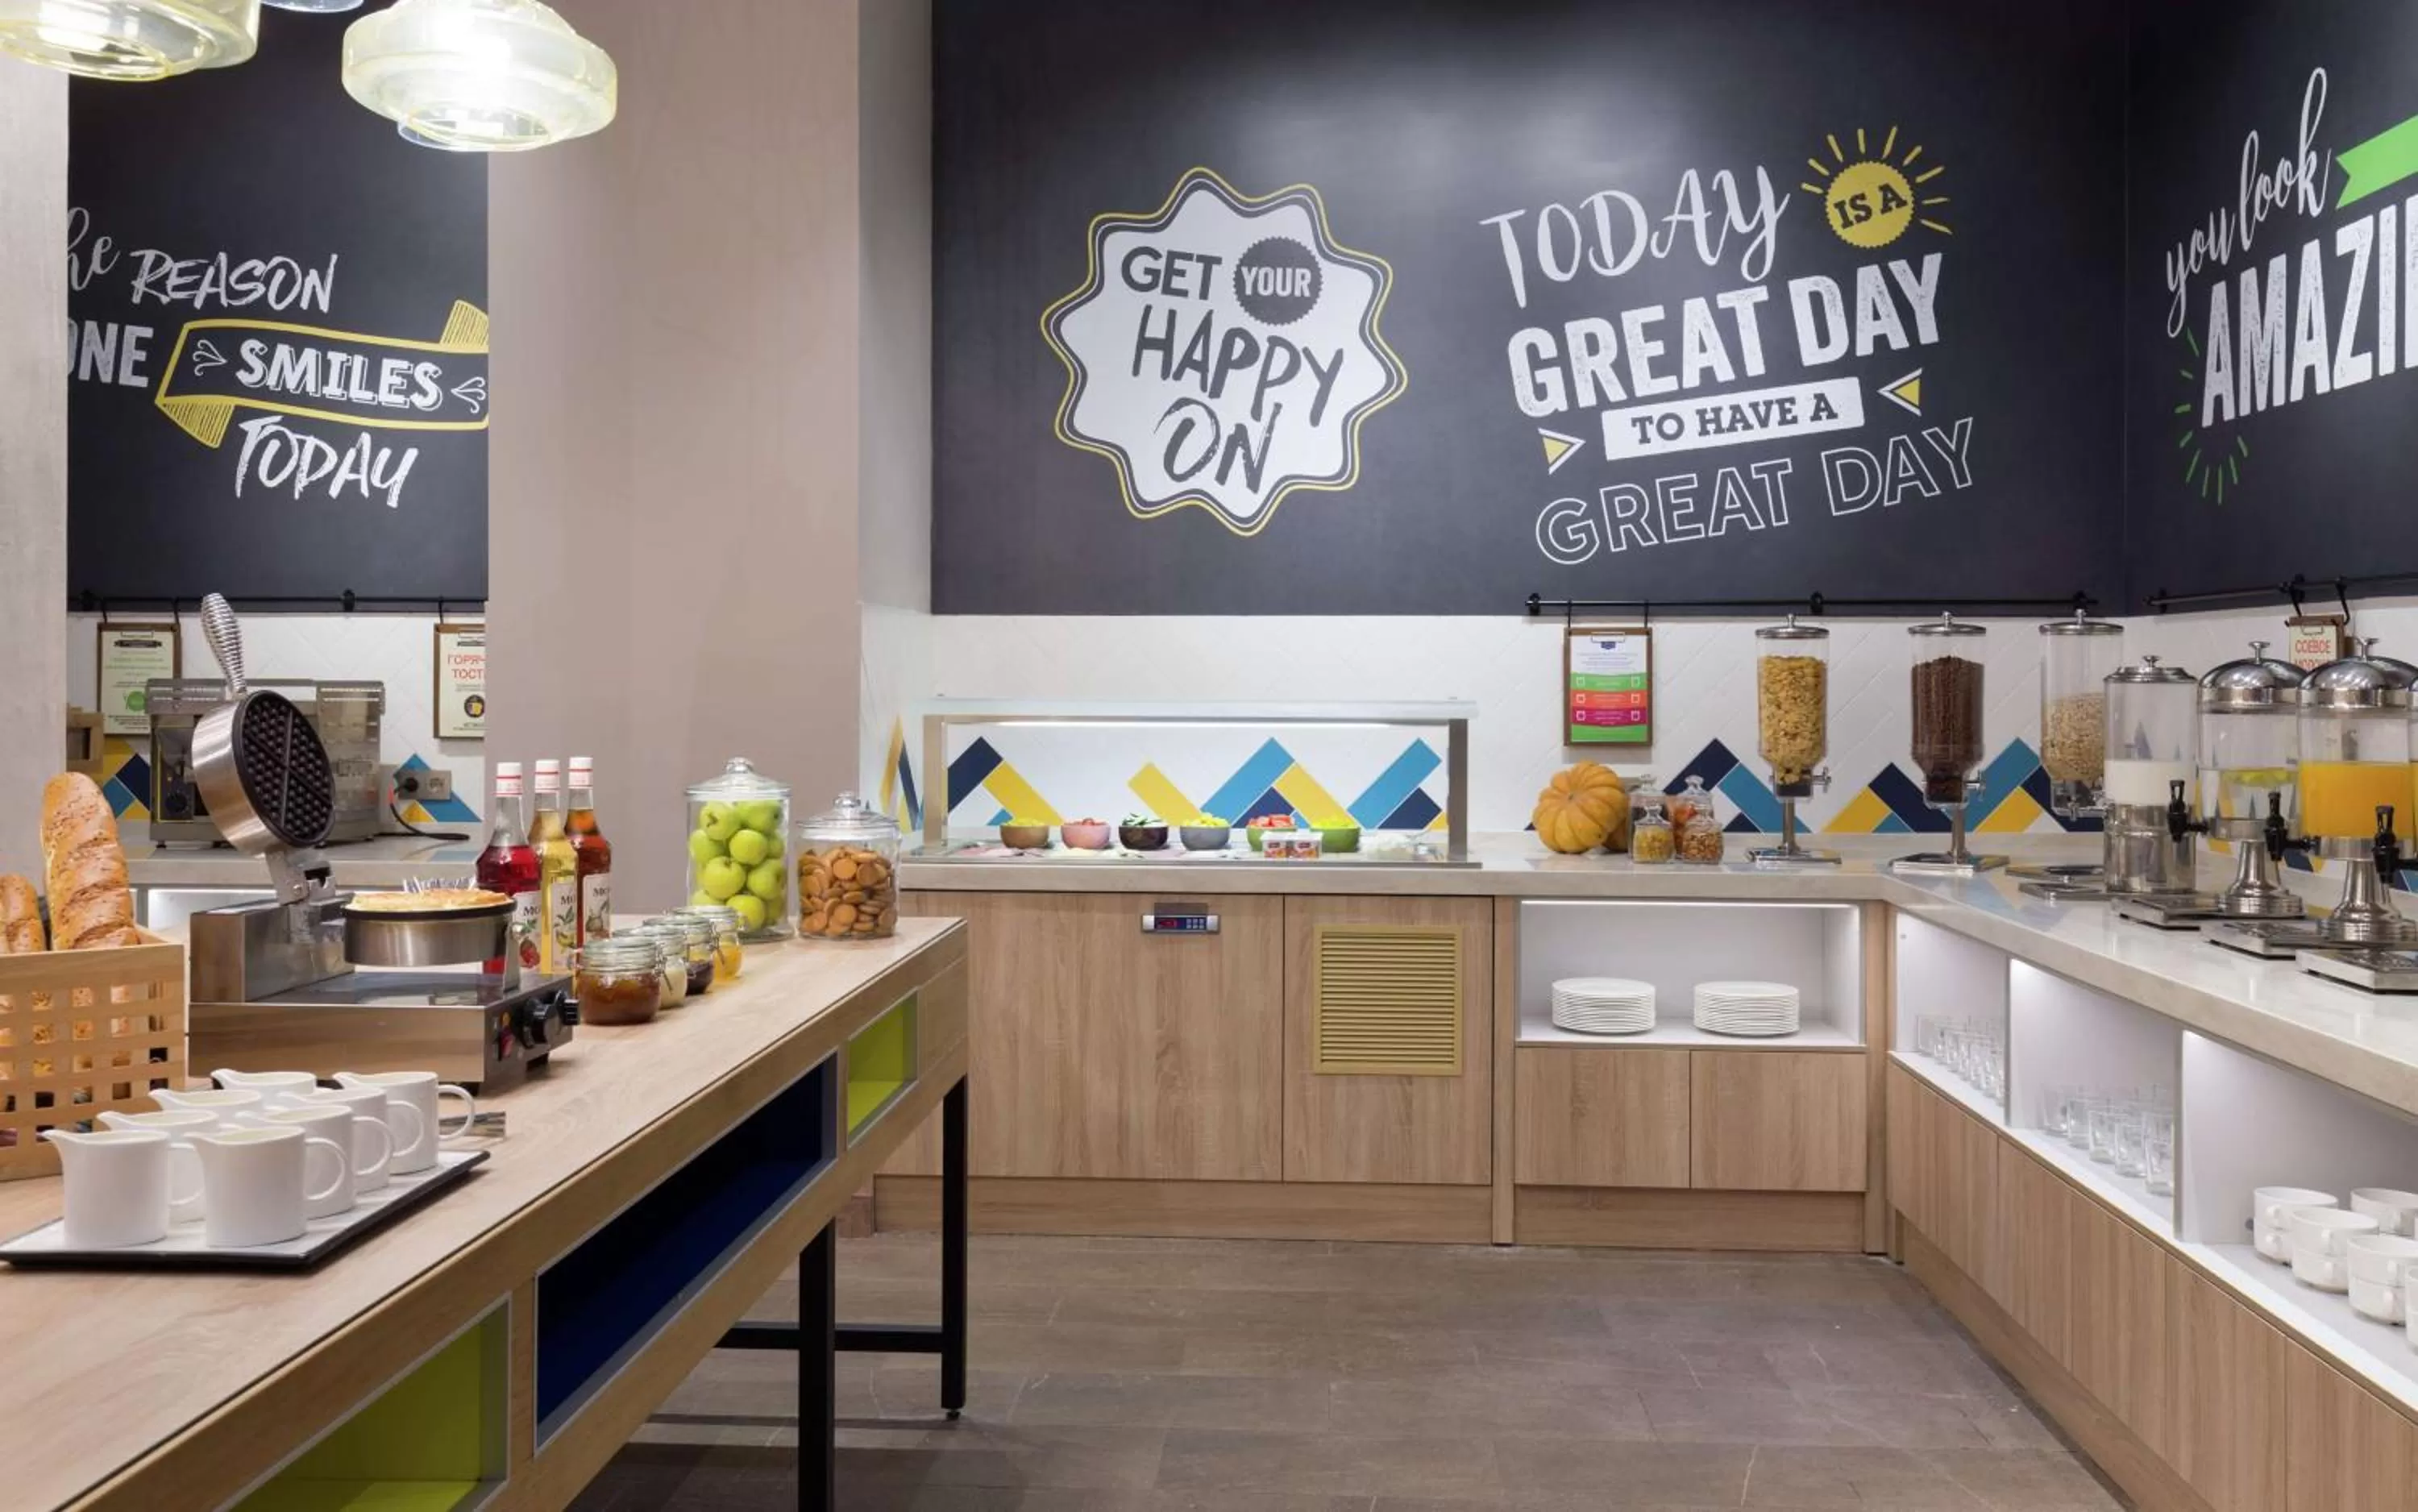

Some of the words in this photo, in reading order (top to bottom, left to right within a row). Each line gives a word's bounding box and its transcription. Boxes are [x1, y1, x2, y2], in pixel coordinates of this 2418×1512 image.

[1479, 165, 1791, 309] TODAY
[1834, 195, 1871, 230] IS
[1879, 182, 1909, 213] A
[2167, 207, 2237, 339] you
[2240, 67, 2333, 252] look
[129, 248, 339, 314] REASON
[1121, 246, 1222, 301] GET
[1240, 266, 1312, 298] YOUR
[235, 338, 443, 411] SMILES
[1132, 304, 1344, 428] HAPPY
[1507, 286, 1769, 418] GREAT
[1789, 252, 1943, 368] DAY
[234, 415, 420, 508] TODAY
[1153, 397, 1283, 494] ON
[1631, 413, 1685, 446] TO
[1697, 397, 1799, 438] HAVE
[1809, 393, 1839, 422] A
[1536, 459, 1793, 565] GREAT
[1821, 417, 1974, 517] DAY
